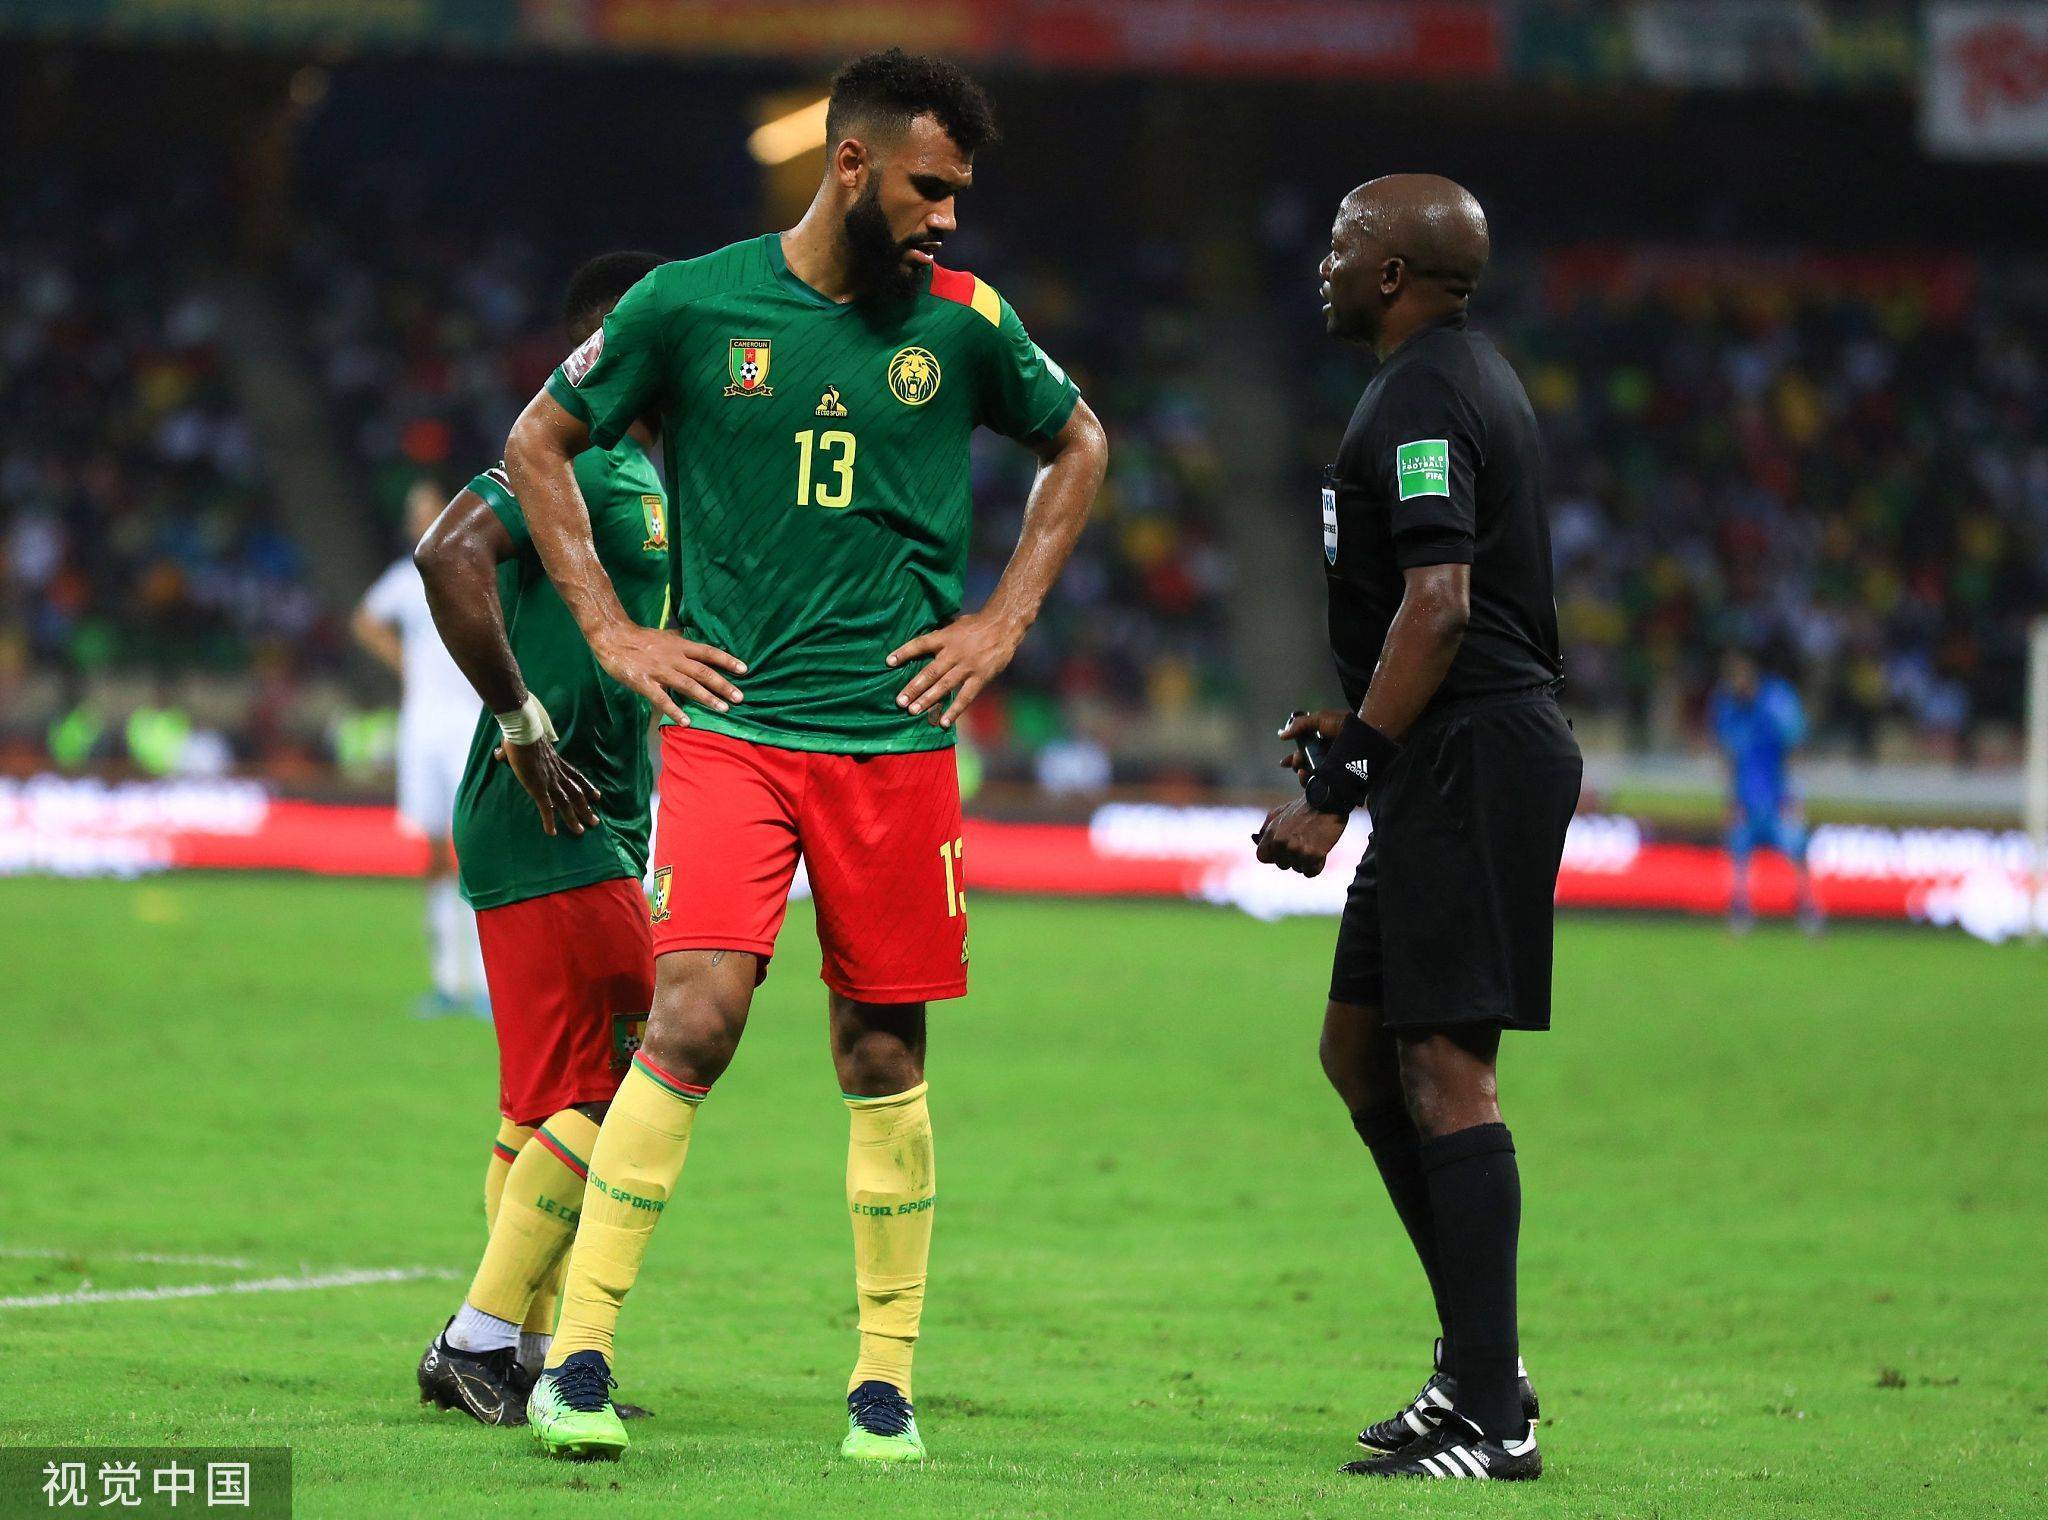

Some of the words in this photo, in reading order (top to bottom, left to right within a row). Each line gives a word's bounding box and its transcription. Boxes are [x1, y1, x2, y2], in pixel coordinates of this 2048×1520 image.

[1402, 456, 1444, 465] LIVING
[1402, 461, 1444, 471] FOOTBALL
[795, 430, 857, 508] 13
[1425, 472, 1443, 480] FIFA
[1323, 494, 1335, 512] IFA
[1345, 763, 1368, 780] adidas
[535, 1194, 556, 1214] LE
[558, 1205, 581, 1224] CO
[852, 1203, 860, 1214] LE
[862, 1205, 893, 1217] COQ
